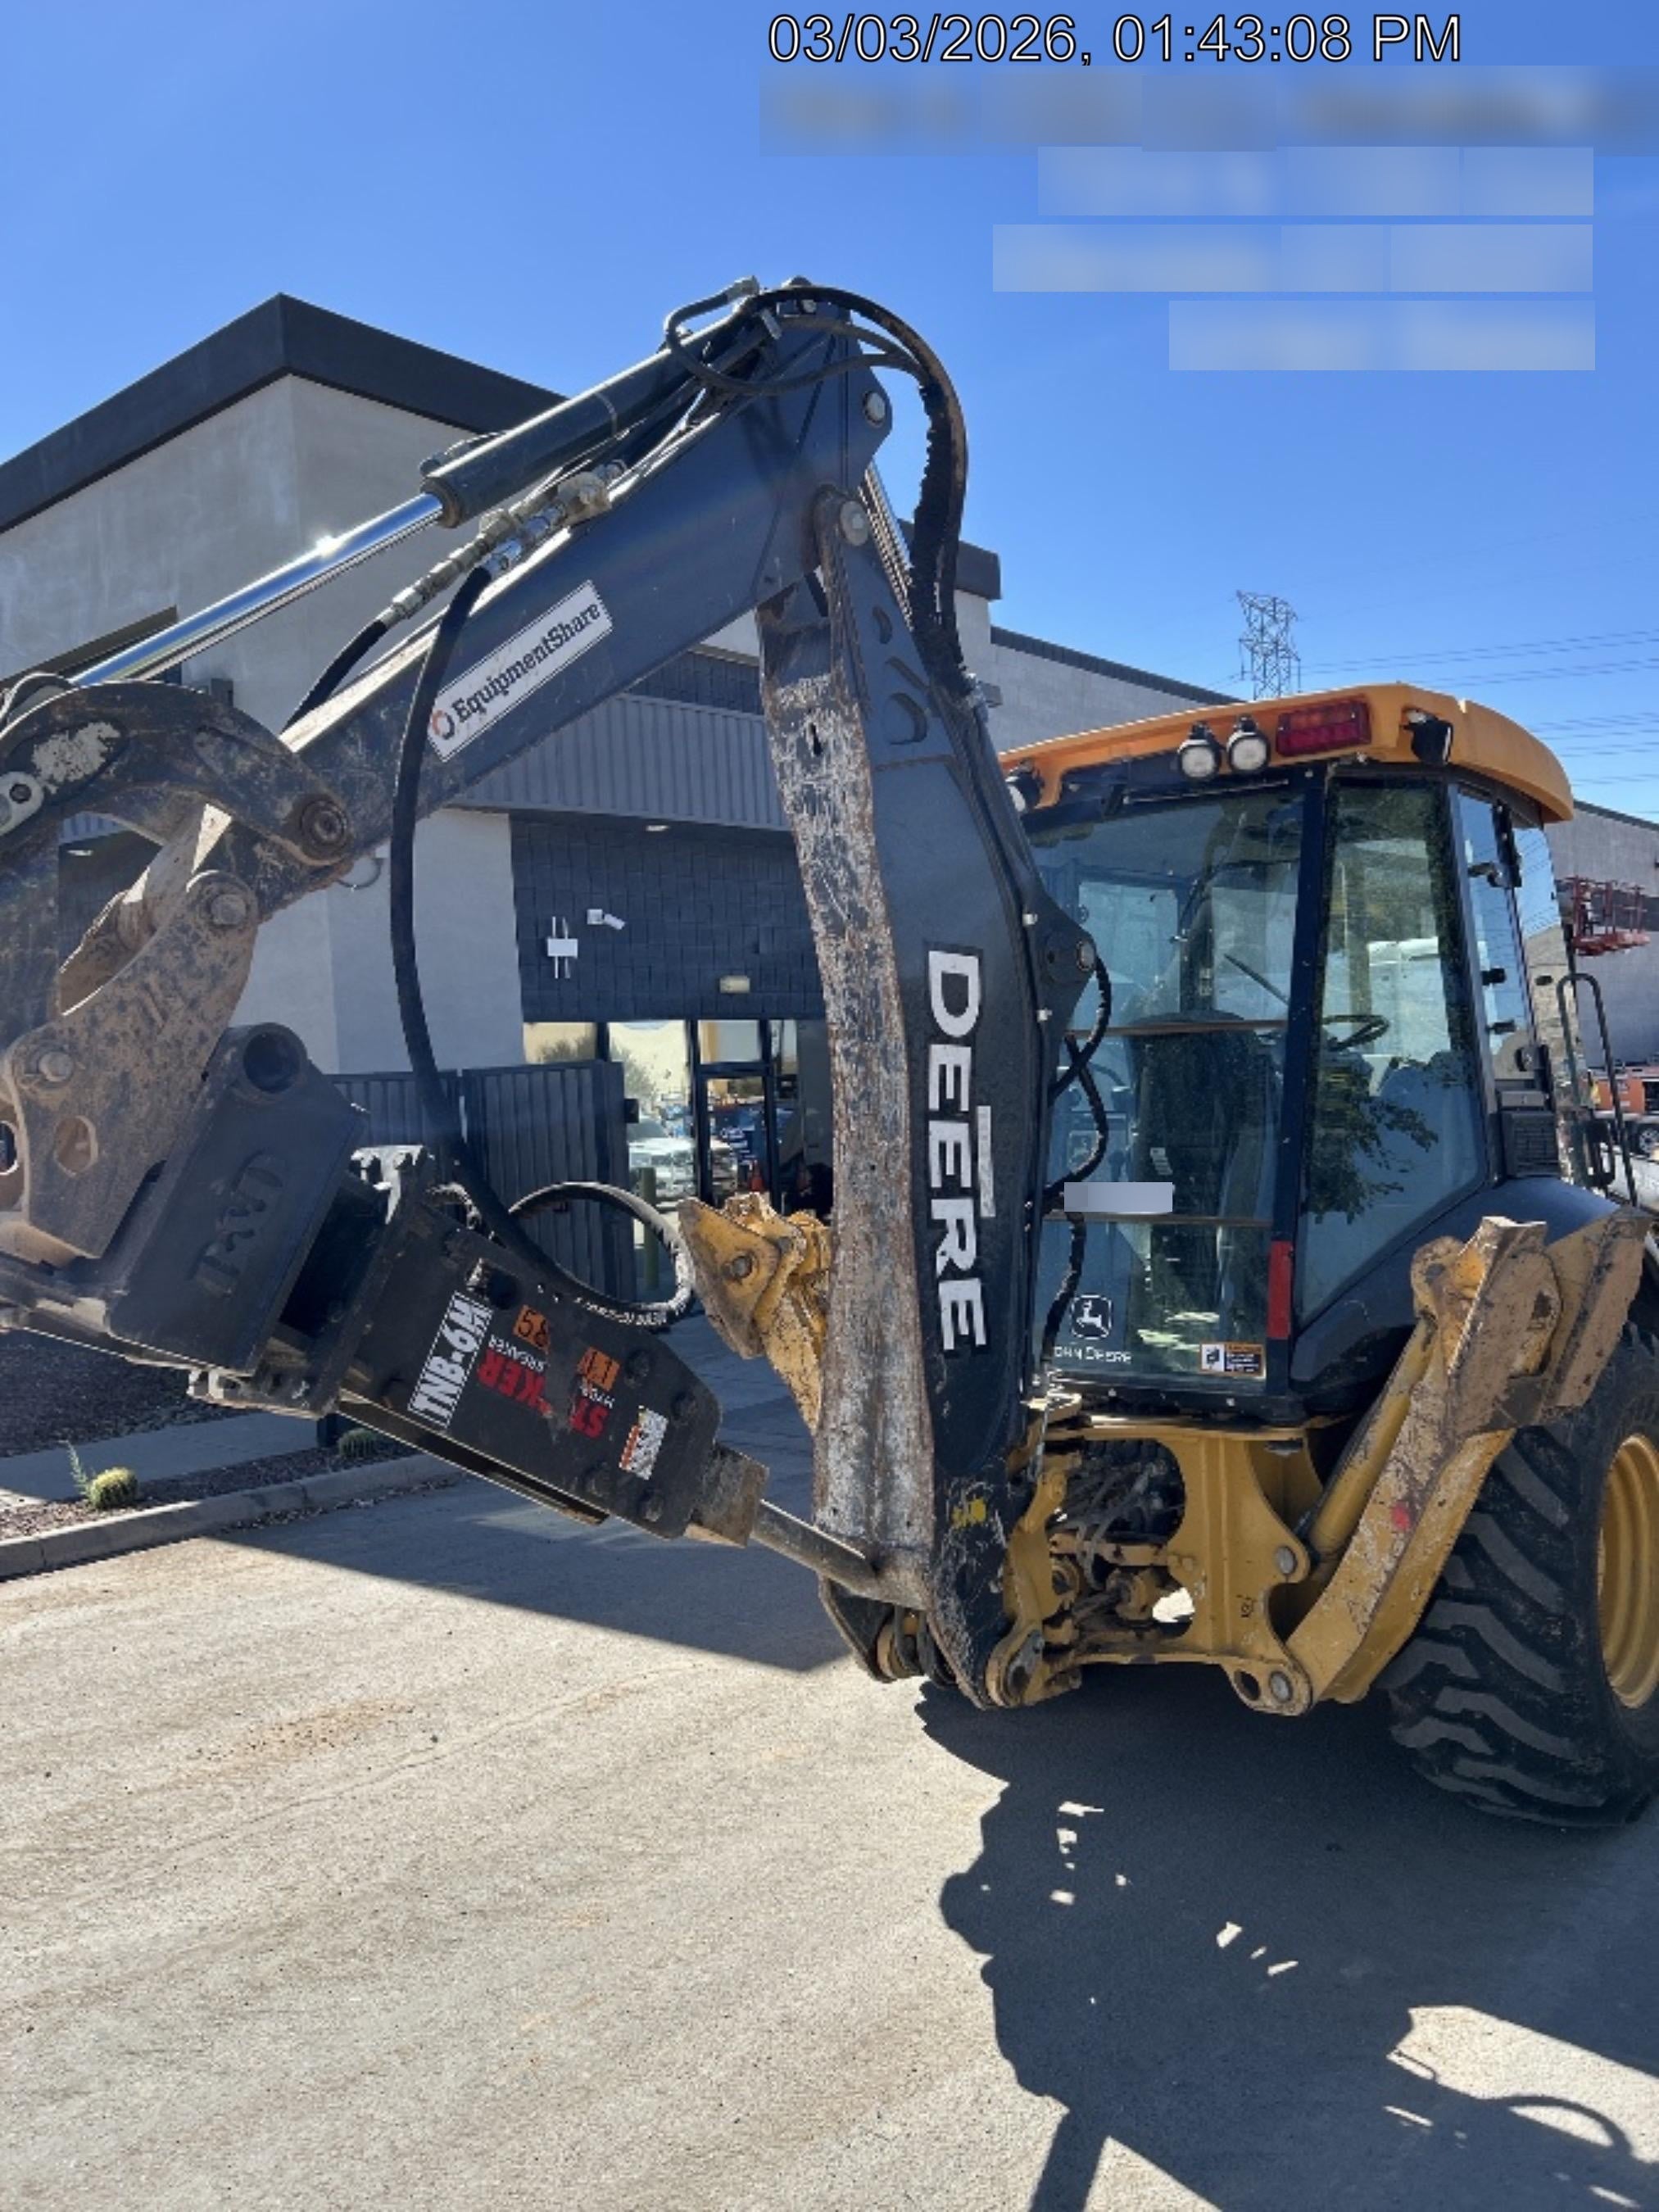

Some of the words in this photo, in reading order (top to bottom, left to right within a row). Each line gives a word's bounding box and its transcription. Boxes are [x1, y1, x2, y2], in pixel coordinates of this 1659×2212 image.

[451, 603, 601, 723] EquipmentShare
[928, 951, 986, 1350] DEERE
[1051, 1346, 1082, 1360] OHN
